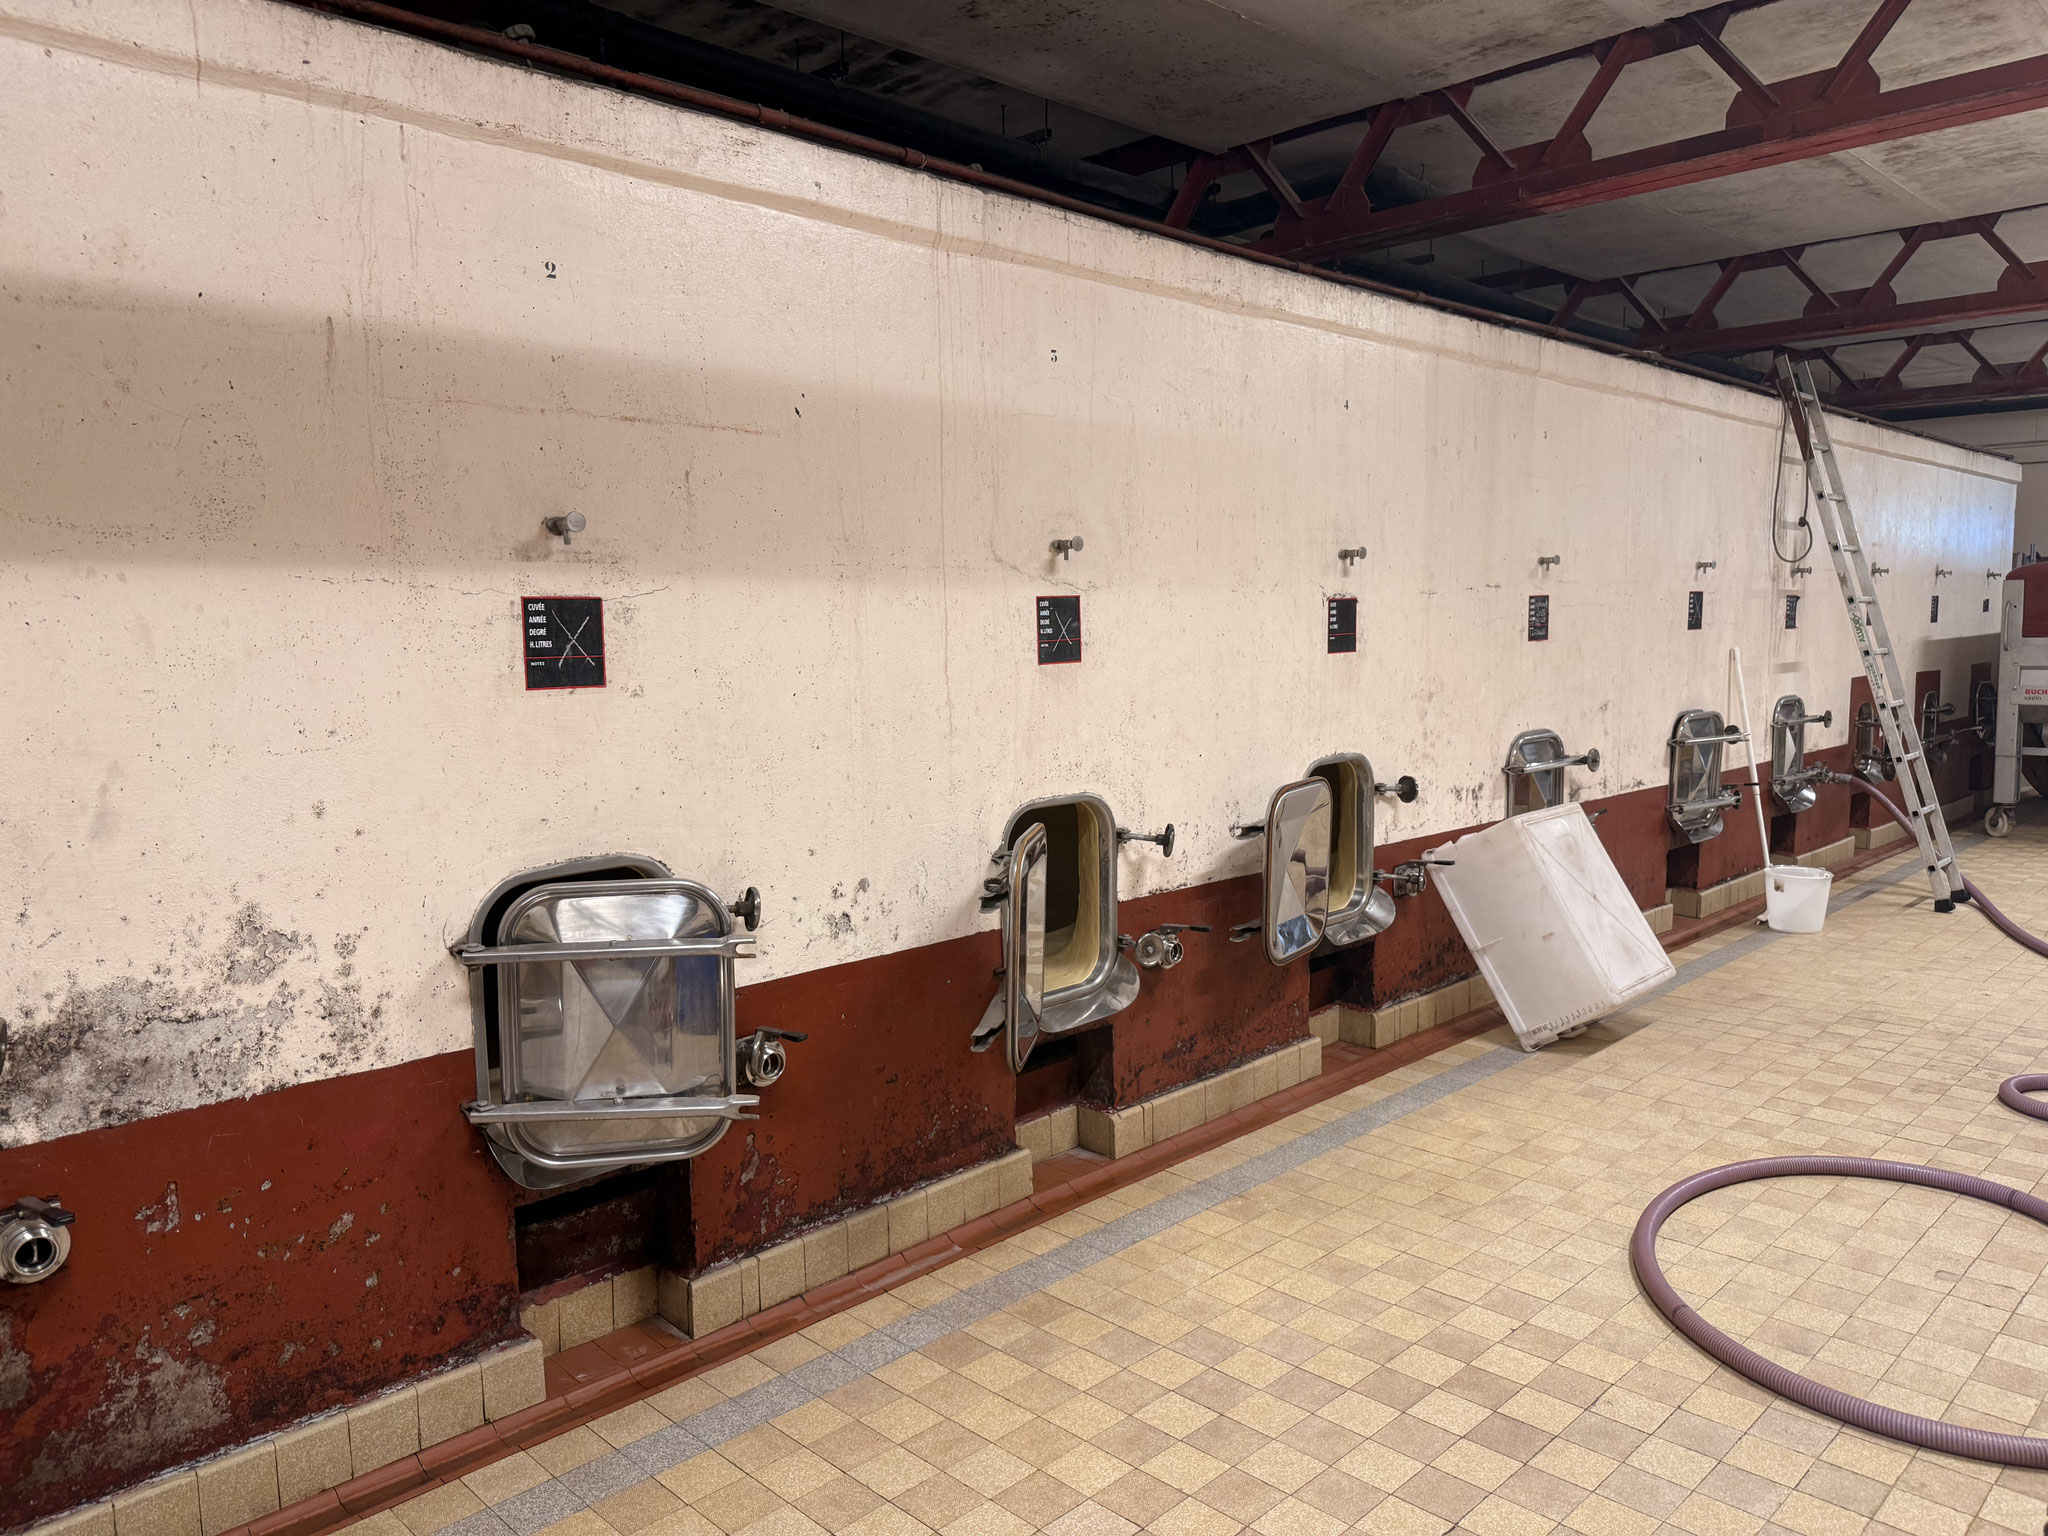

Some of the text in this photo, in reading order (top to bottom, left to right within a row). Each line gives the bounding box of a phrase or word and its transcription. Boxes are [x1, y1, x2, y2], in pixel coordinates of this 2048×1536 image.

[544, 261, 557, 279] 2
[528, 602, 545, 611] CUVÉE
[529, 615, 547, 623] ANNÉE
[529, 627, 547, 635] DEGRÉ
